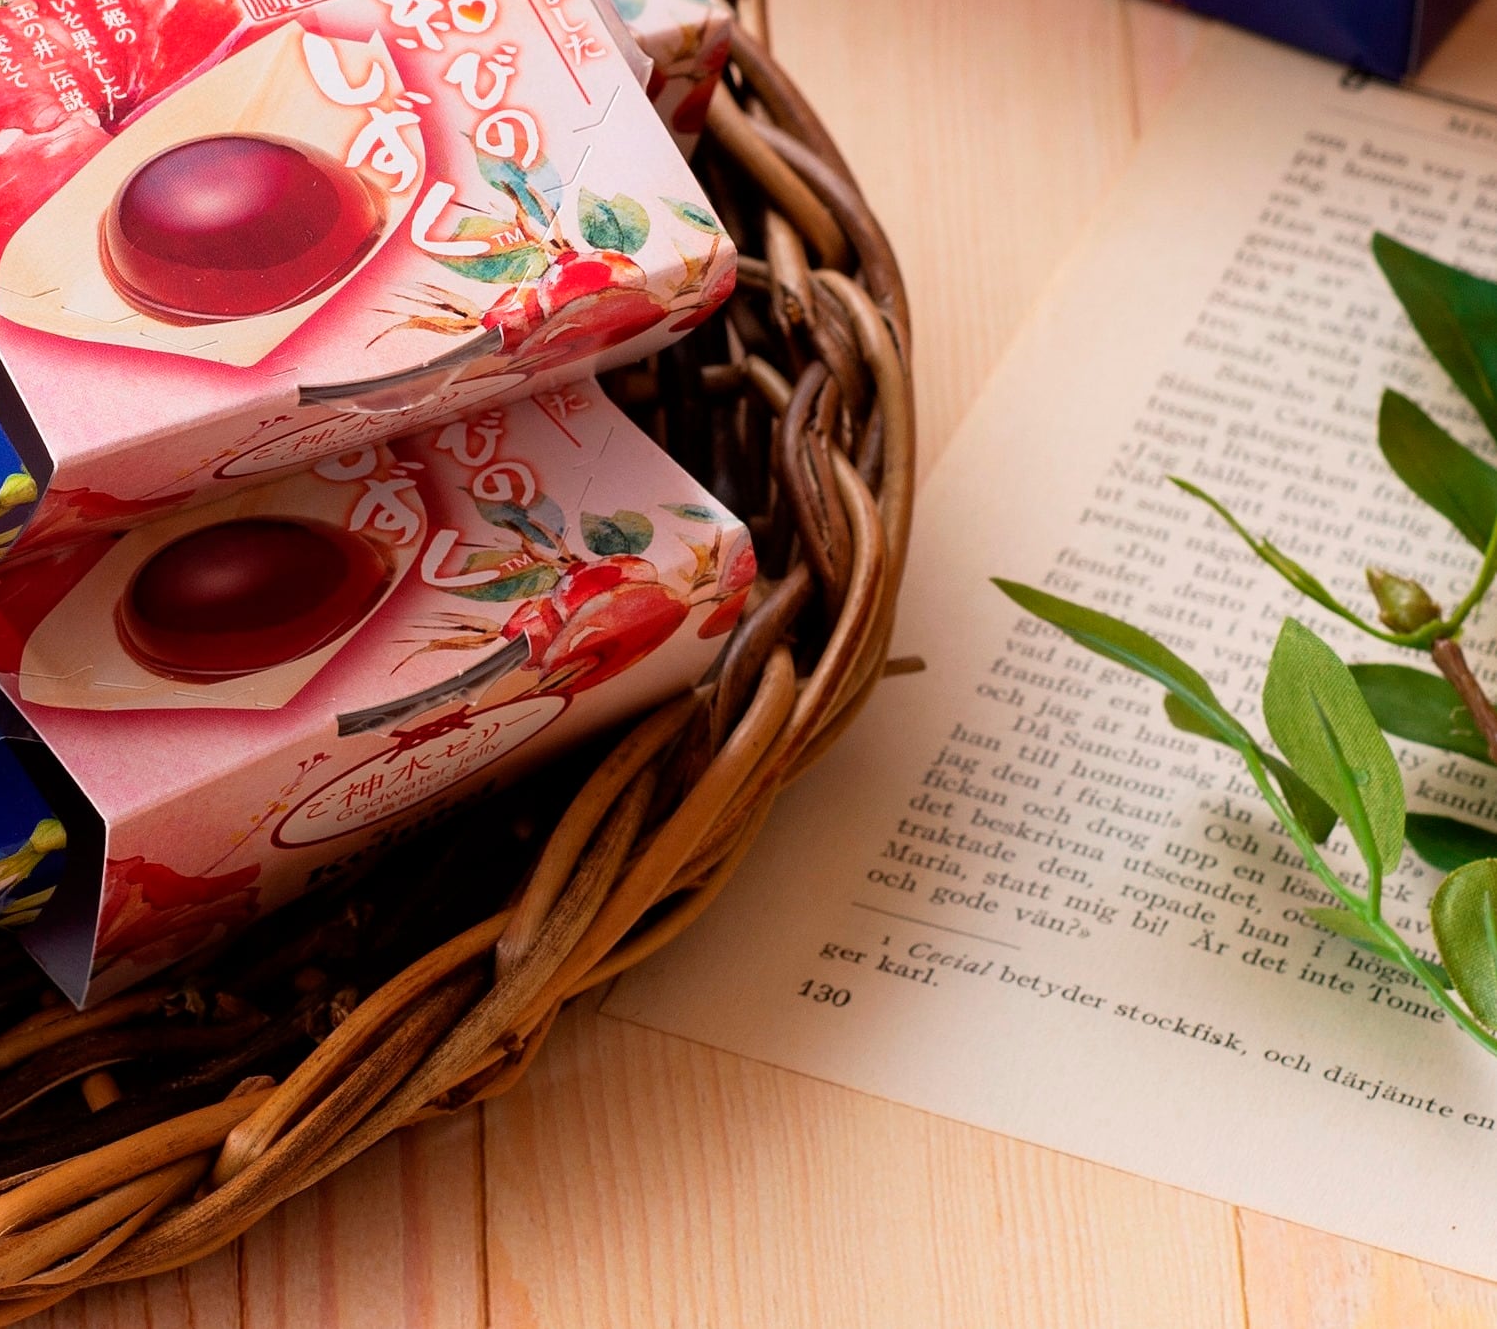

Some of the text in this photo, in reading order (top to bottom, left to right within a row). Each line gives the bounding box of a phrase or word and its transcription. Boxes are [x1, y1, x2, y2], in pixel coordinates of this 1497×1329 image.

[303, 31, 525, 257] しずく TM
[436, 409, 535, 506] びの
[1078, 506, 1170, 542] person
[498, 553, 533, 575] TM
[1092, 588, 1134, 609] att
[988, 656, 1151, 717] framför era
[1005, 637, 1057, 663] vad
[1062, 655, 1093, 674] ni
[974, 682, 1199, 755] och jag är hans
[1010, 714, 1217, 791] Då Sancho såg
[305, 707, 543, 820] ご神水ゼリー
[334, 757, 451, 828] Godwater
[947, 721, 1001, 752] han
[1016, 743, 1060, 769] till
[1067, 758, 1175, 801] honom:
[919, 767, 1007, 806] fickan
[1021, 801, 1072, 825] och
[1085, 816, 1150, 851] drog
[1164, 841, 1219, 872] upp
[1231, 864, 1266, 885] en
[930, 744, 980, 775] jag
[990, 762, 1040, 790] den
[1203, 823, 1260, 856] Och
[896, 816, 1016, 862] traktade
[1036, 855, 1093, 889] den,
[1119, 883, 1216, 925] ropade
[1236, 916, 1290, 948] han
[907, 791, 954, 818] det
[969, 807, 1103, 861] beskrivna
[1123, 857, 1262, 915] utseendet,
[865, 868, 1091, 939] och gode vän?»
[878, 839, 966, 880] Maria,
[981, 871, 1052, 901] statt
[1062, 894, 1120, 925] mig
[1130, 909, 1170, 937] bi!
[1187, 927, 1231, 956] Är
[1240, 946, 1288, 974] det
[1297, 961, 1355, 995] inte
[796, 978, 852, 1008] 130
[817, 941, 938, 987] ger karl.
[906, 941, 994, 976] Cecial
[998, 964, 1107, 1009] betyder
[1113, 1003, 1246, 1056] stockfisk,
[1262, 1048, 1311, 1074] och
[1323, 1065, 1454, 1119] därjämte
[1462, 1111, 1496, 1132] en
